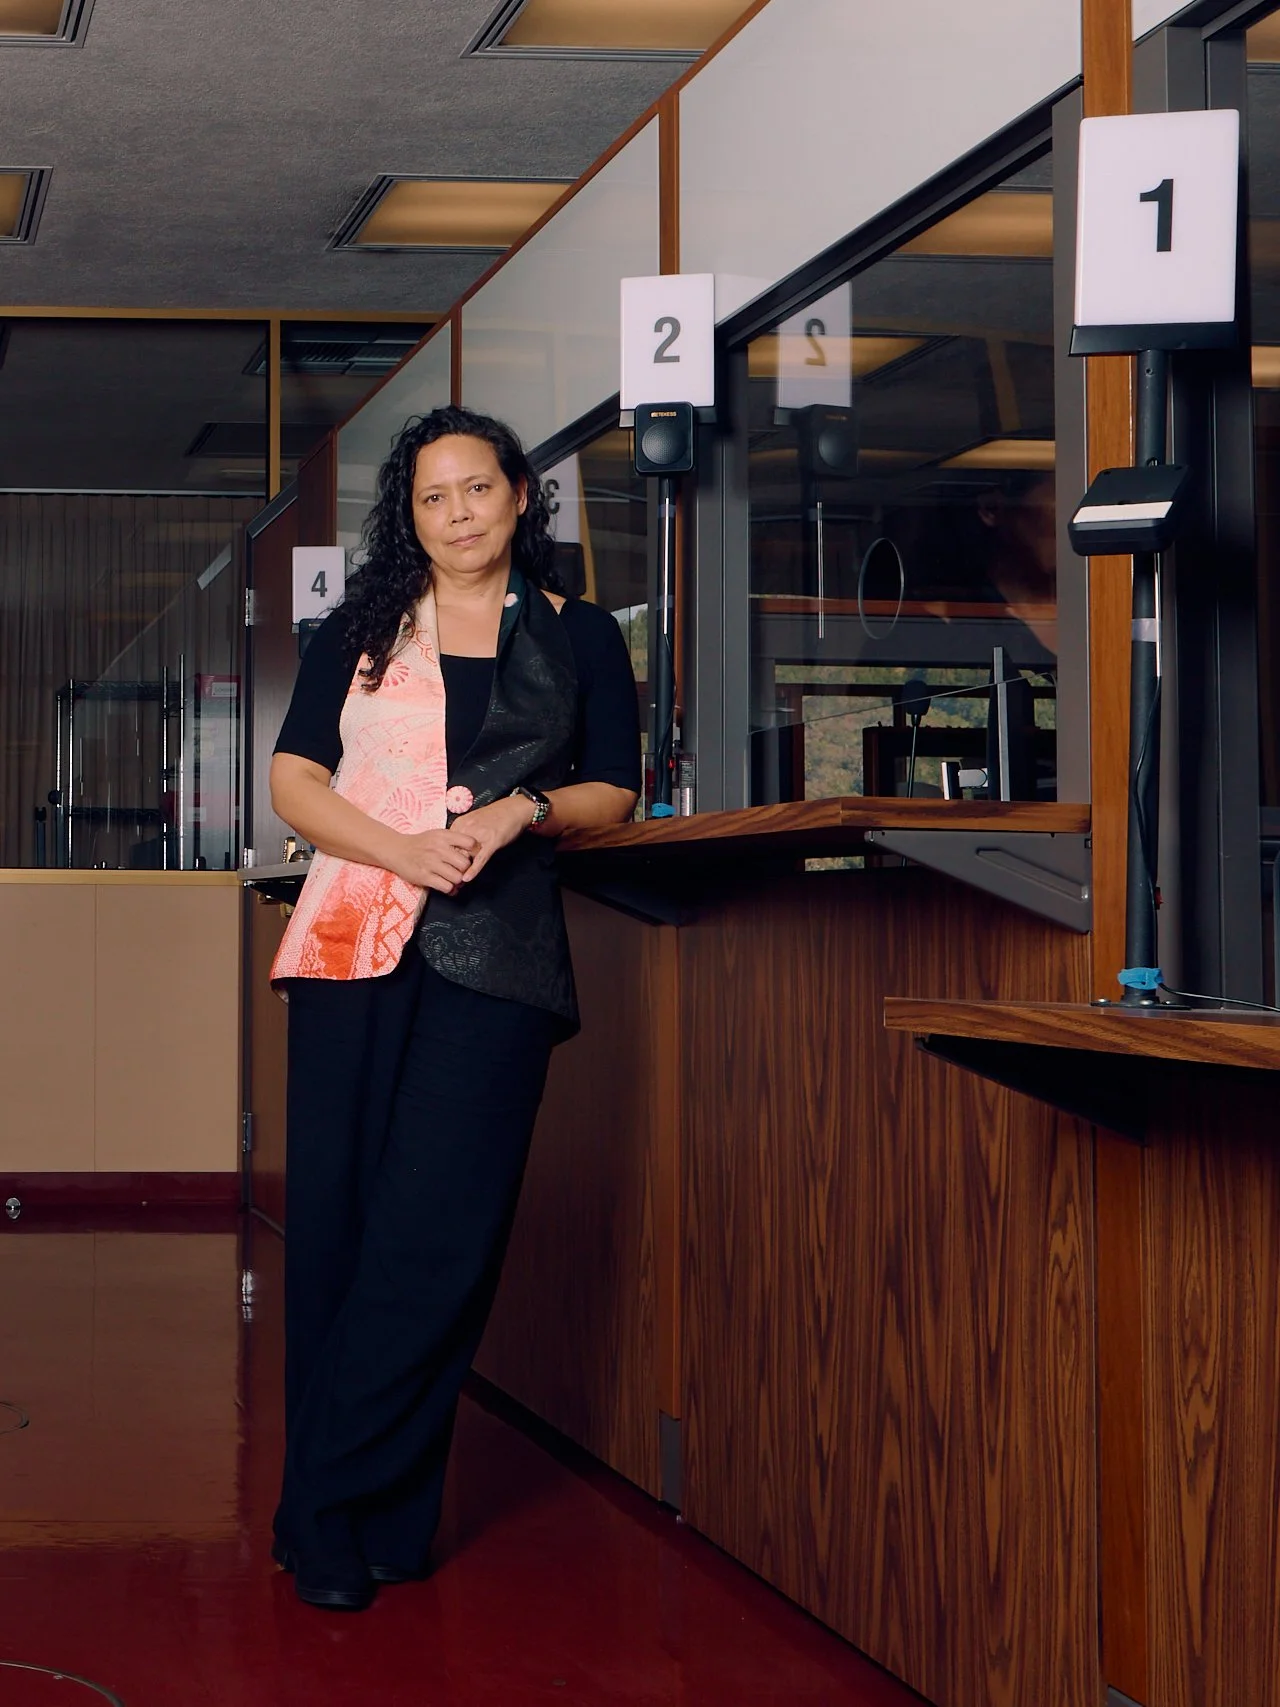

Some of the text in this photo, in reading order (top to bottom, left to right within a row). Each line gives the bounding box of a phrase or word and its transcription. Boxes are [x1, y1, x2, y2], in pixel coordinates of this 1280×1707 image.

[1139, 178, 1174, 253] 1
[653, 316, 681, 364] 2
[311, 569, 328, 598] 4
